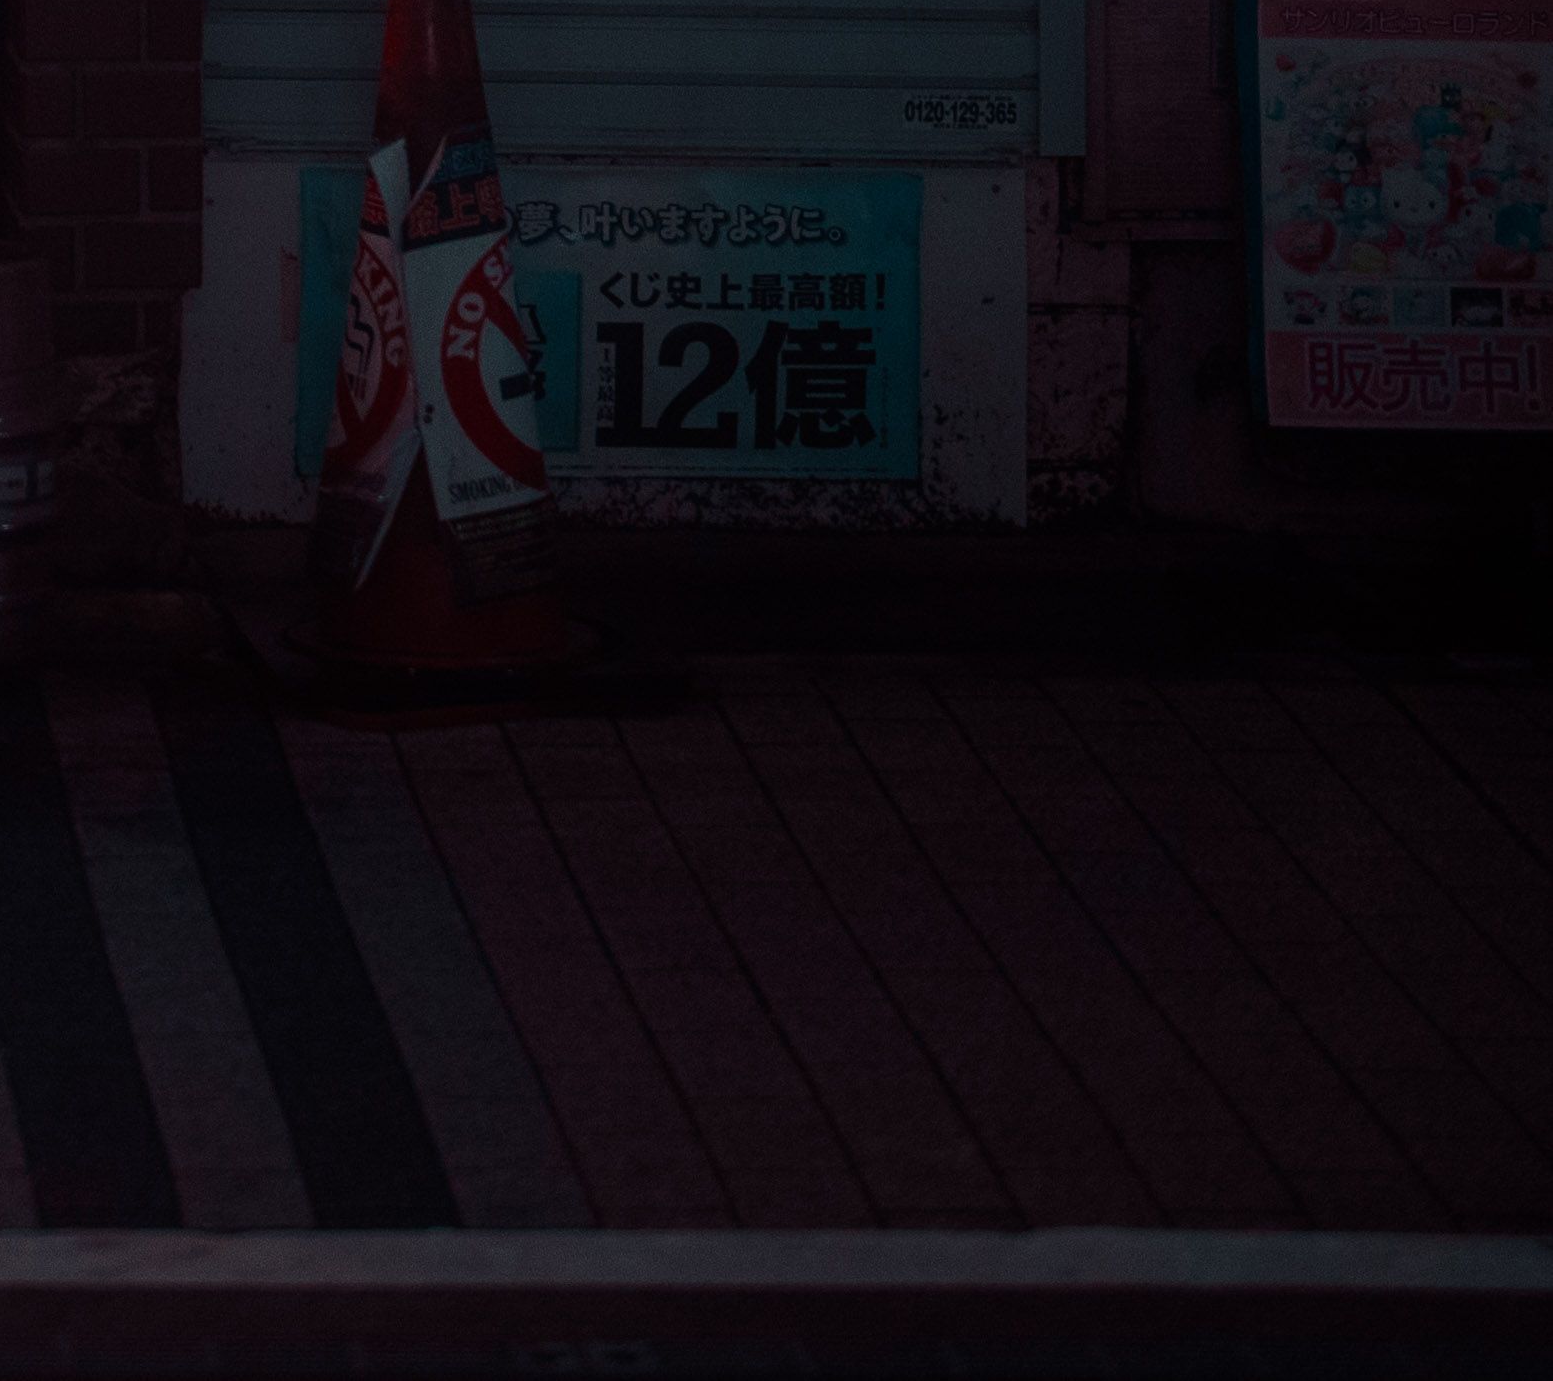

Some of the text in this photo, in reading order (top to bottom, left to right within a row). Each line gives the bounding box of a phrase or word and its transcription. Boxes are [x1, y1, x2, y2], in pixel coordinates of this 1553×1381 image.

[904, 100, 1017, 125] 0120-129-365
[598, 271, 888, 311] くじ史上最高額!
[595, 319, 878, 451] 12億
[1306, 339, 1540, 416] 販売中!
